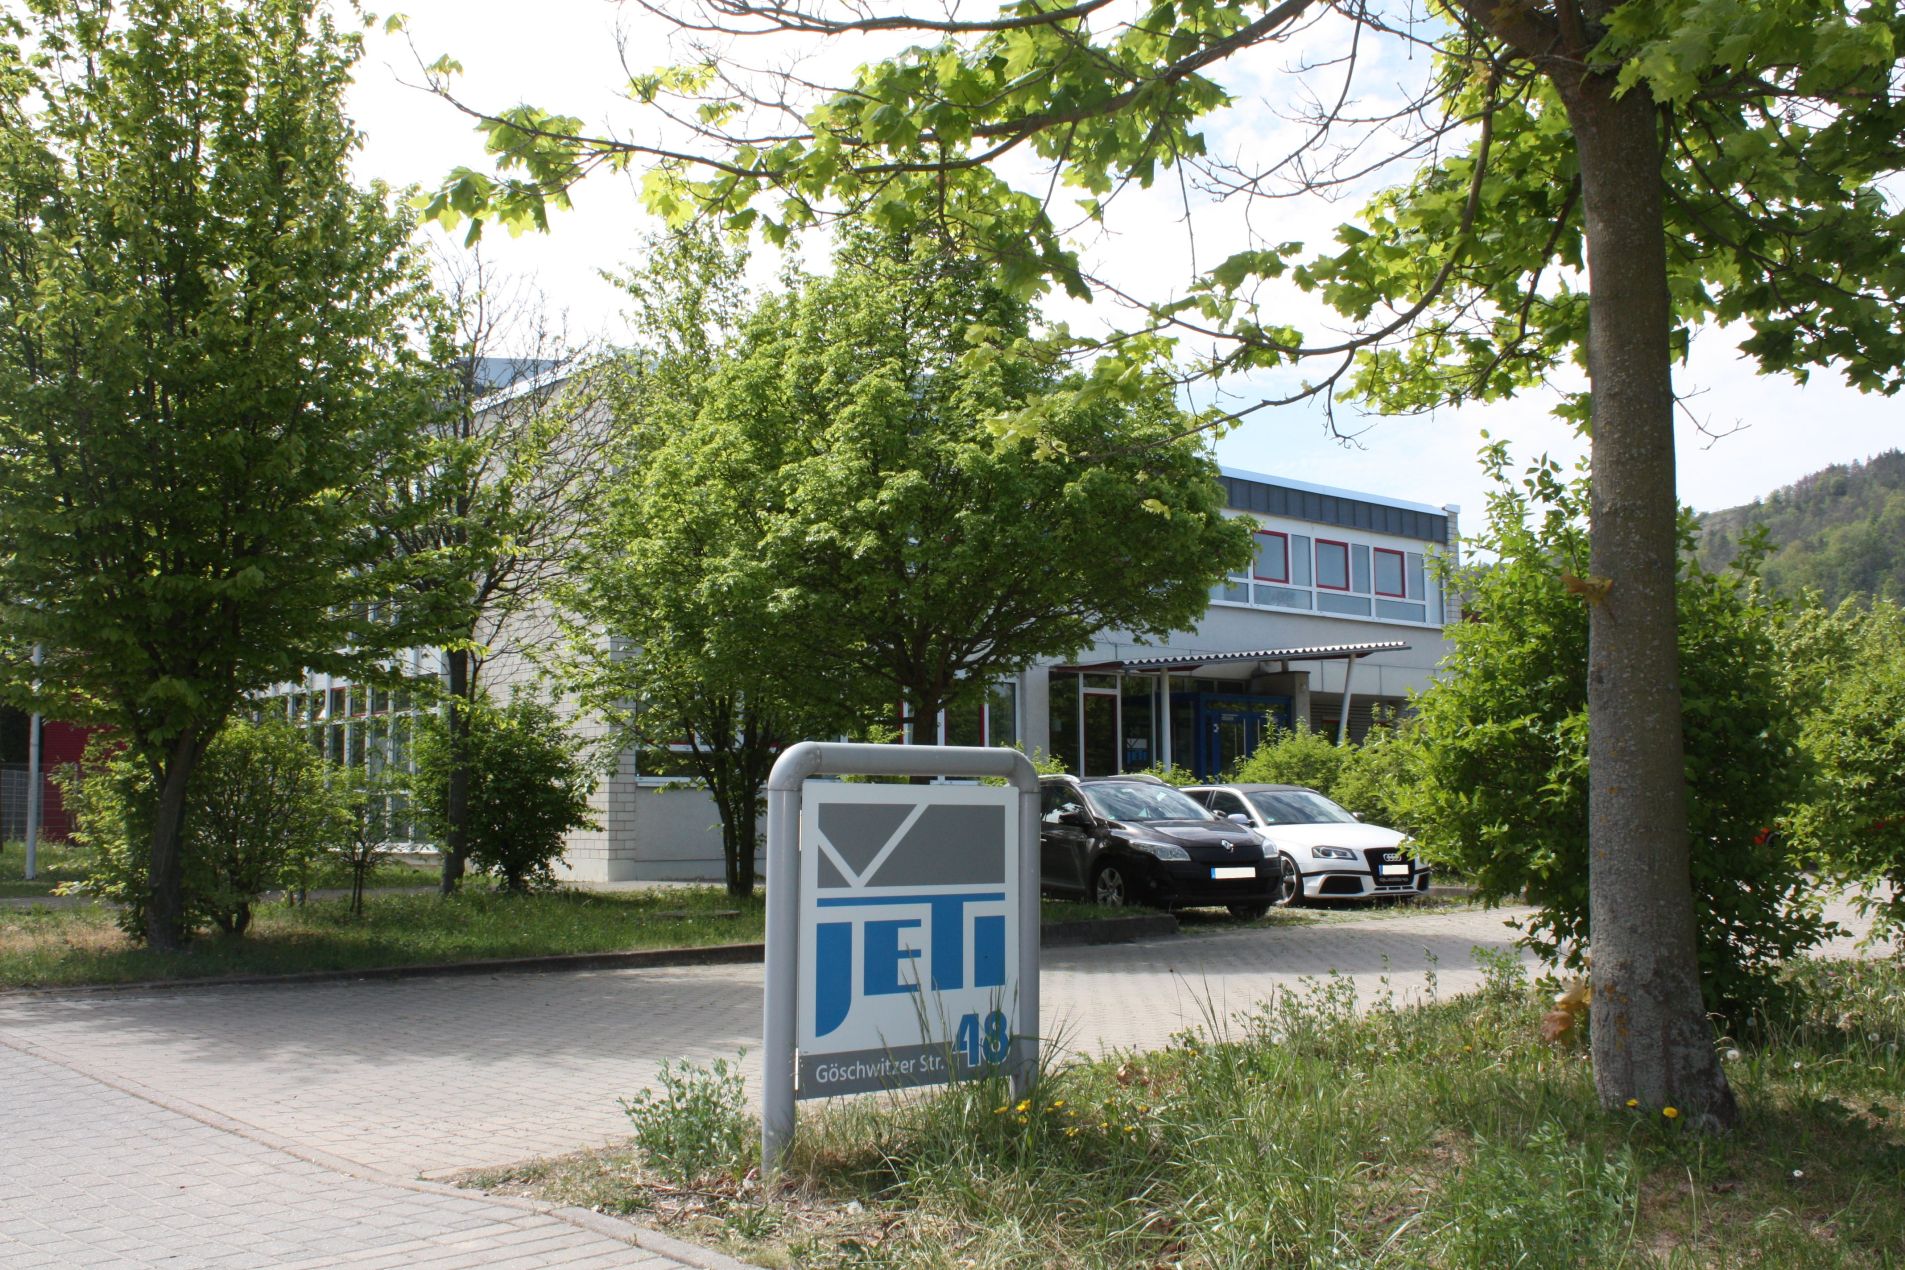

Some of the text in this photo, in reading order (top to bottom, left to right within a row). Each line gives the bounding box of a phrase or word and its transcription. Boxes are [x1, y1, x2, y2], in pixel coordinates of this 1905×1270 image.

[816, 892, 1005, 1038] JETI
[816, 1010, 1011, 1083] Göschwitzer Str. 48
